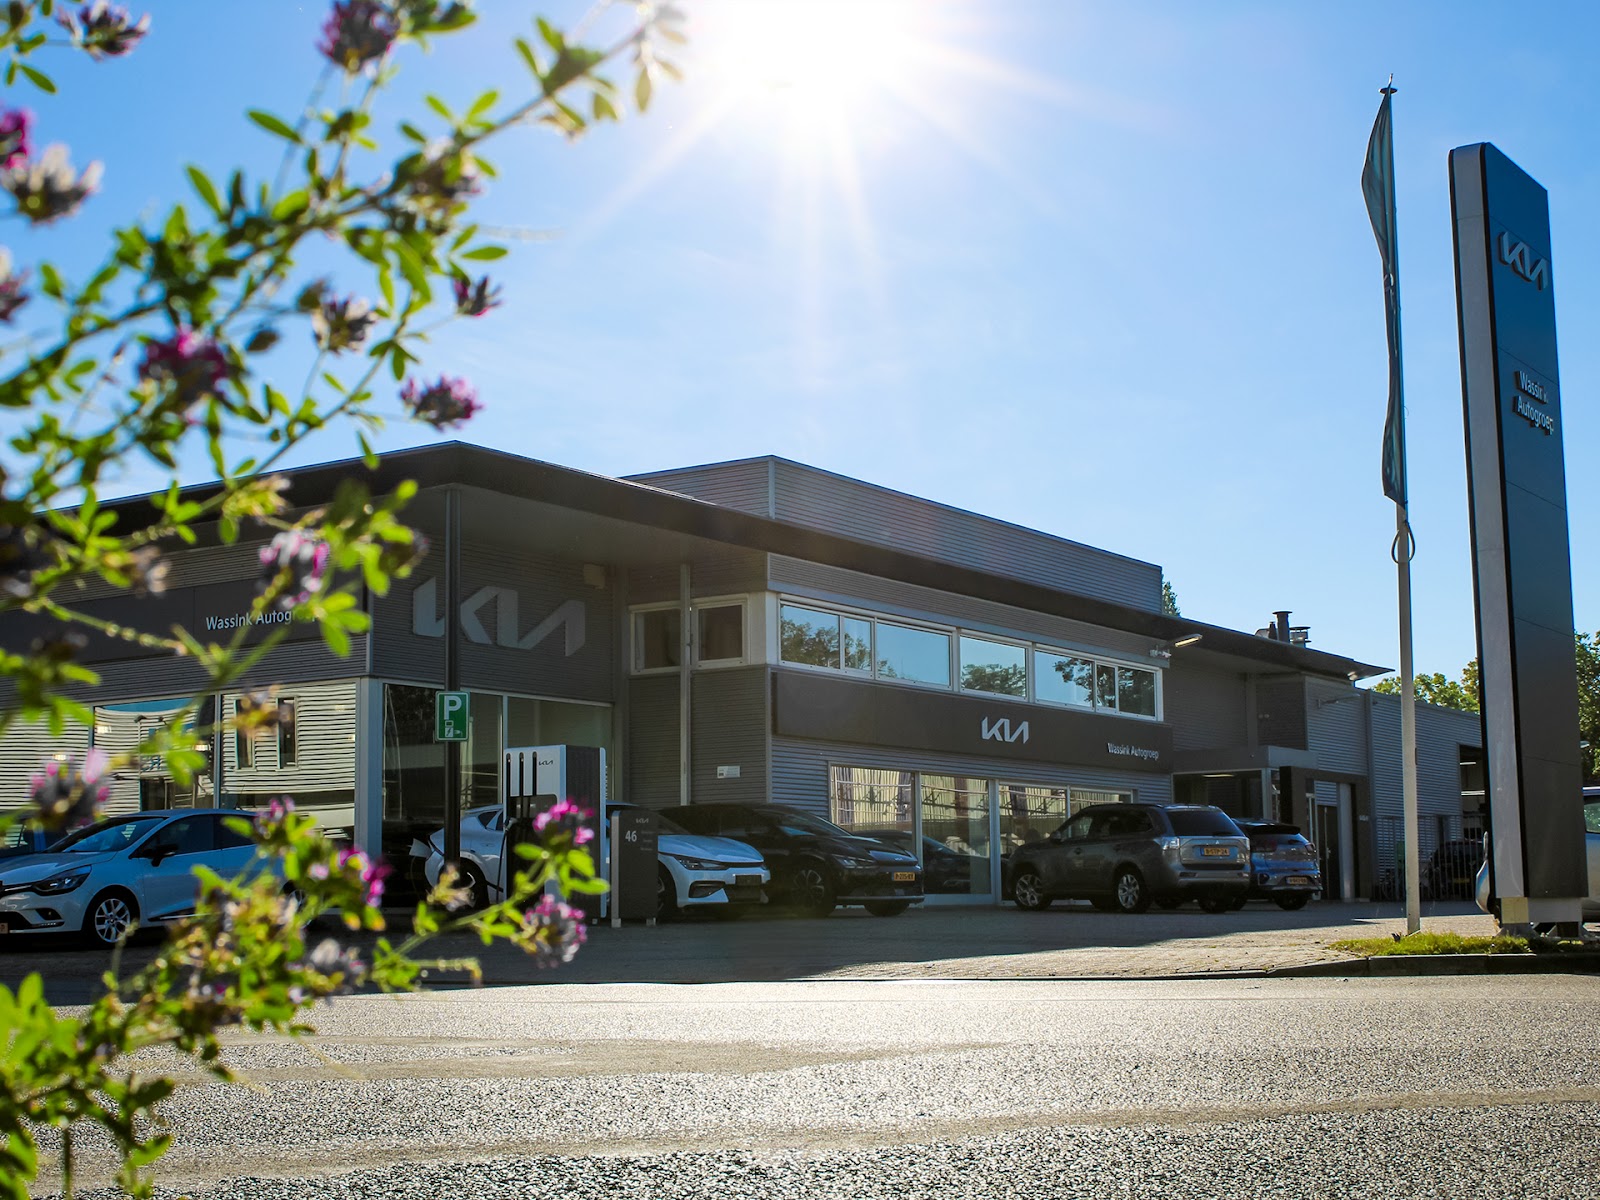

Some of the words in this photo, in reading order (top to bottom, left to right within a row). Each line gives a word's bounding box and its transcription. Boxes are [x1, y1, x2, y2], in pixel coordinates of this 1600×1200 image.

[206, 611, 253, 631] Wassink
[444, 695, 462, 720] P
[981, 716, 1030, 744] KIA
[624, 830, 638, 842] 46
